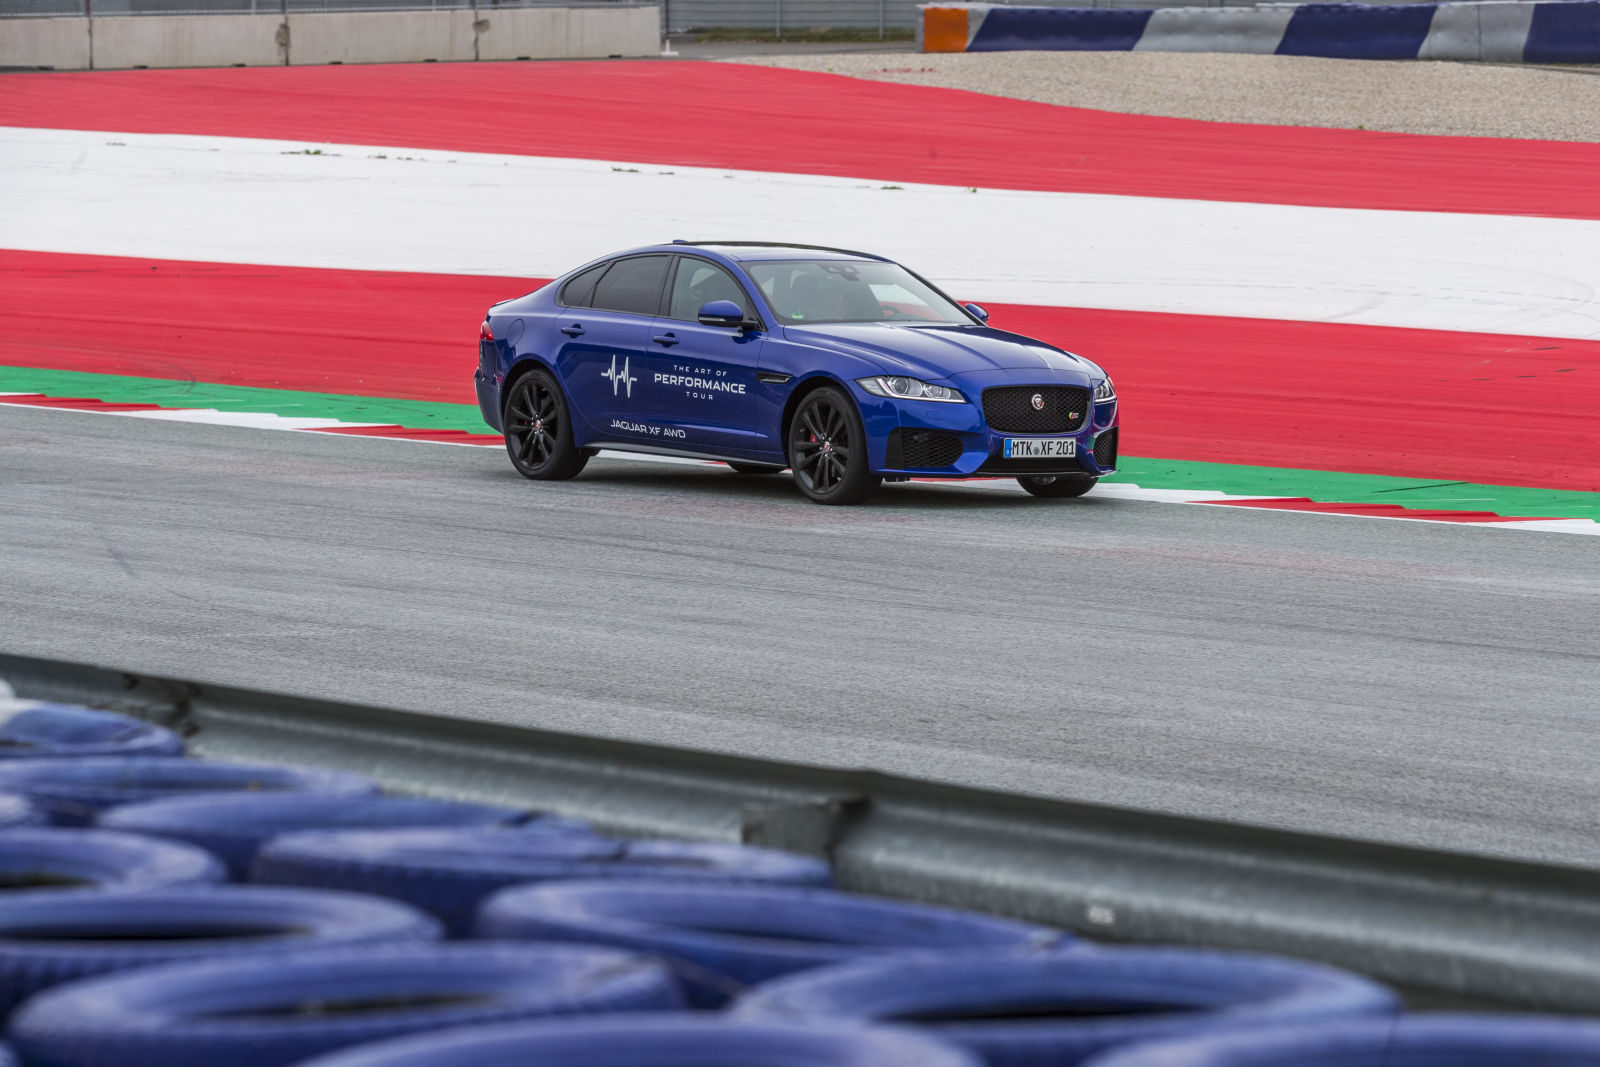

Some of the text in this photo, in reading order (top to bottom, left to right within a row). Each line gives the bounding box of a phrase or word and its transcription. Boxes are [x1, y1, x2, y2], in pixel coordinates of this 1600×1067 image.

[695, 367, 711, 375] ART
[654, 373, 746, 394] PERFORMANCE
[686, 391, 713, 400] TOUR
[610, 419, 686, 438] JAGUAR XF AWD
[1012, 440, 1075, 456] MTK XF 201
